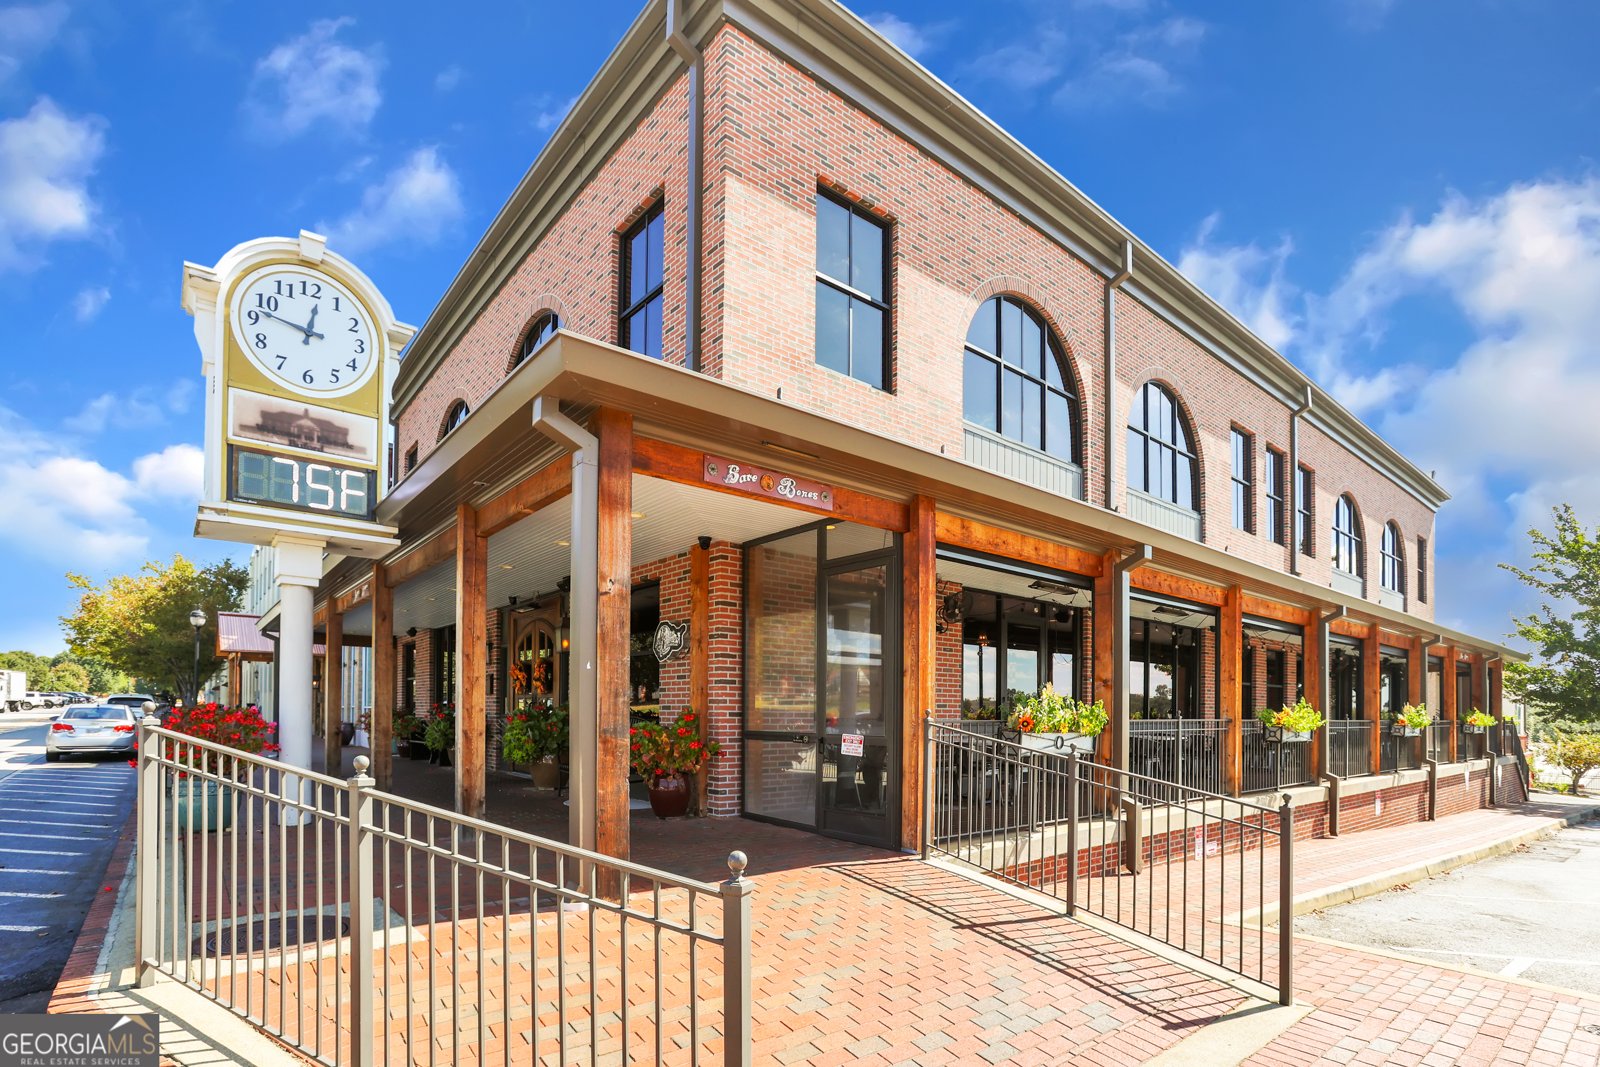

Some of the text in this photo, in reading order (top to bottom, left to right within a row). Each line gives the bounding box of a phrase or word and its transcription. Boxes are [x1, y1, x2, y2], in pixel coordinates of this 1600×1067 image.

[274, 280, 295, 299] 11
[299, 280, 322, 300] 12
[255, 293, 279, 312] 10
[332, 297, 341, 312] 1
[247, 309, 260, 325] 9
[348, 317, 359, 333] 2
[255, 332, 267, 349] 8
[354, 338, 365, 354] 3
[275, 354, 288, 370] 7
[345, 357, 358, 372] 4
[302, 369, 314, 384] 6
[329, 368, 340, 384] 5
[723, 464, 819, 500] Bare Bones
